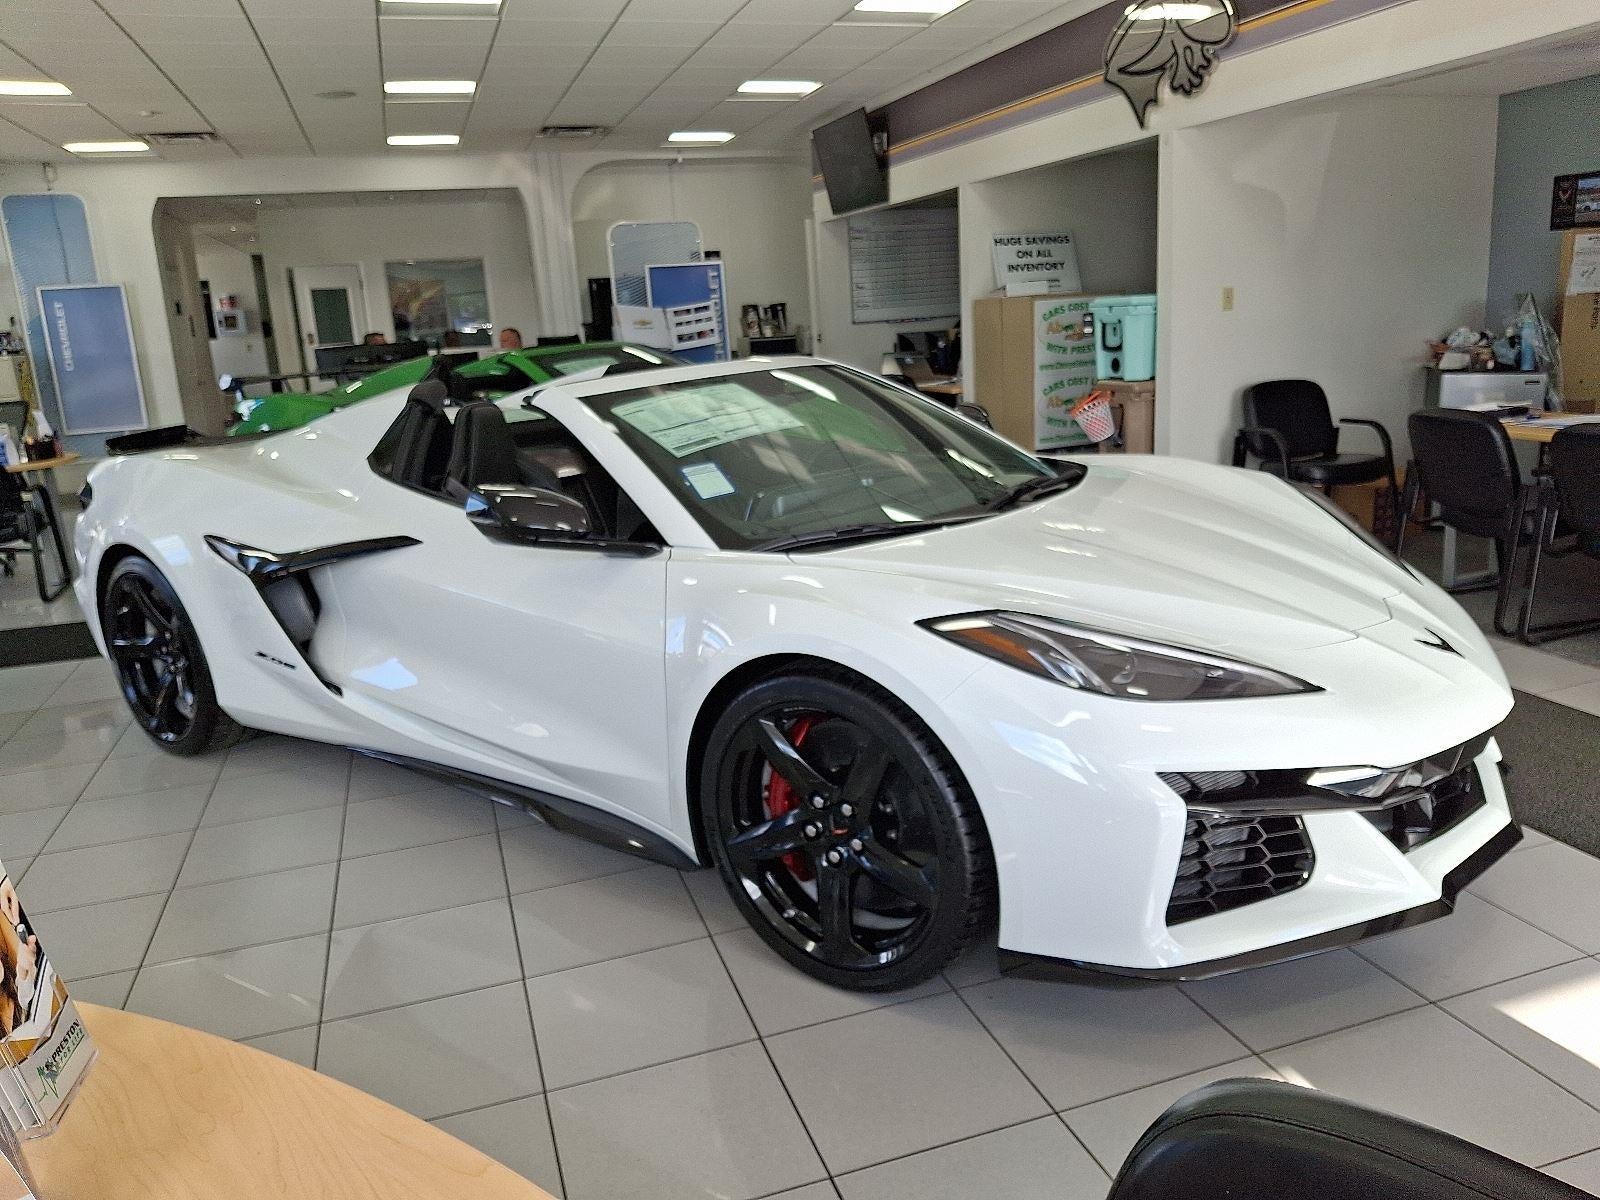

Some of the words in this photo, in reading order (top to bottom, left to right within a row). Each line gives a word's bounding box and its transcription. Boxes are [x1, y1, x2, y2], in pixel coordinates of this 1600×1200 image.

[994, 237, 1023, 247] HUGE
[1025, 235, 1071, 245] SAVINGS
[1016, 250, 1033, 259] ON
[1036, 249, 1053, 258] ALL
[1008, 262, 1065, 273] INVENTORY
[1042, 305, 1065, 321] CARS
[1067, 302, 1089, 312] COST
[54, 302, 74, 371] CHEVROLET
[1042, 380, 1065, 396] CARS
[1067, 377, 1089, 386] COST
[52, 1019, 80, 1062] PRESTON
